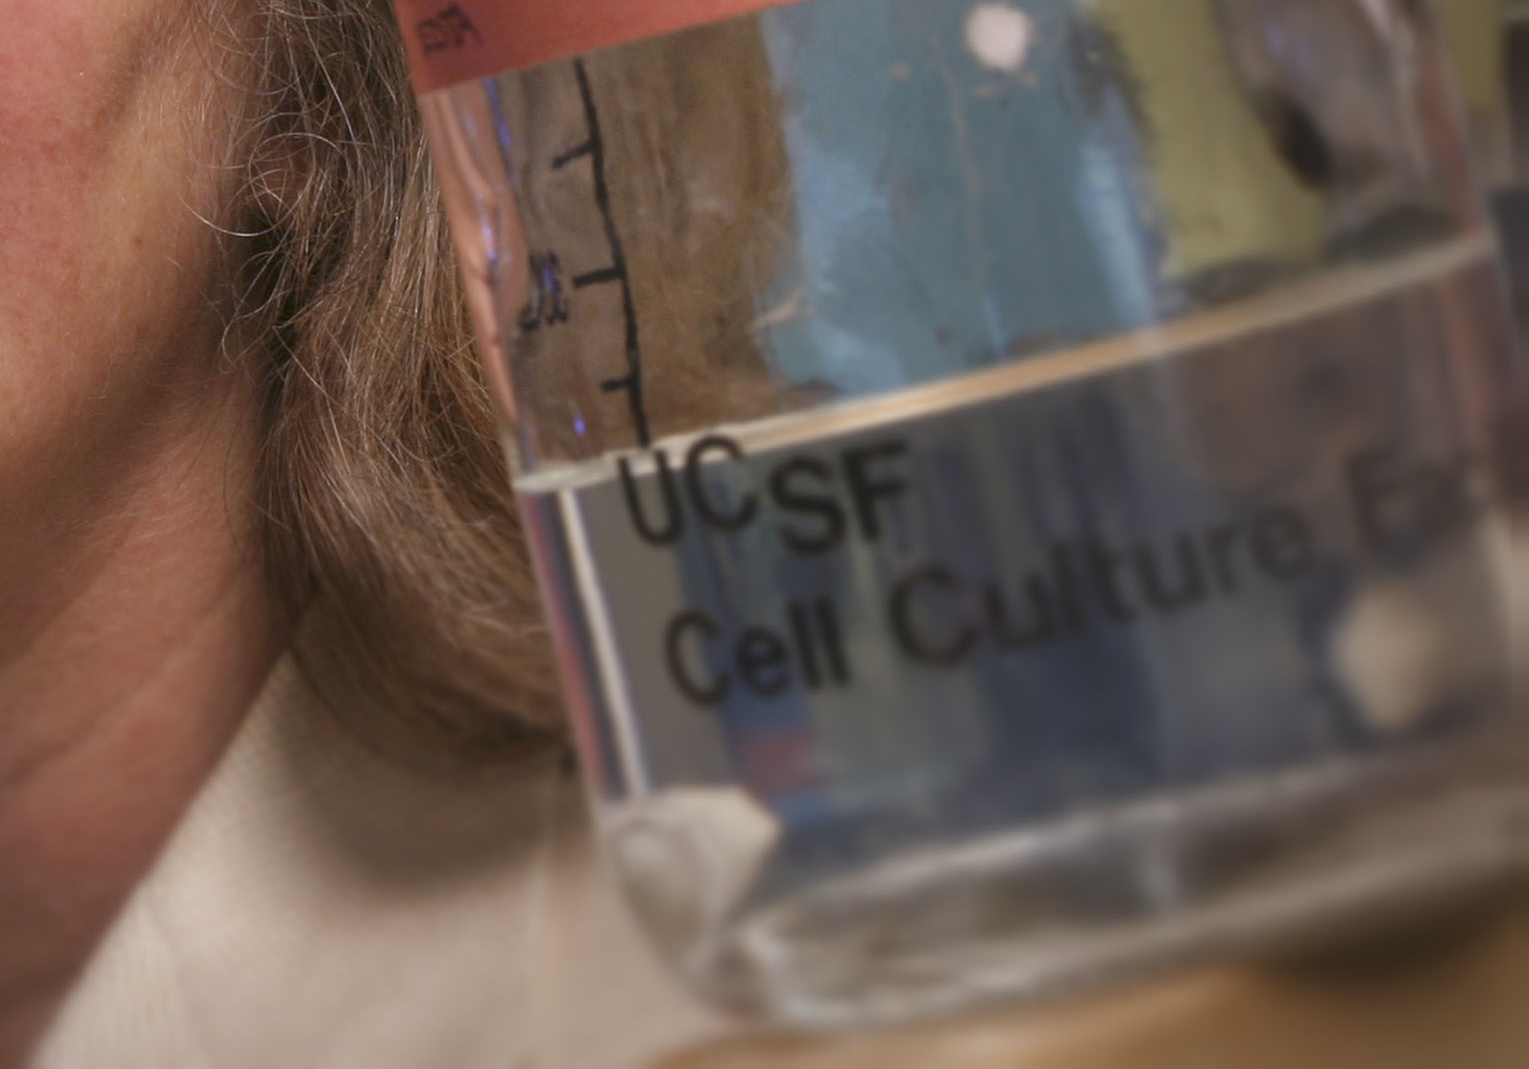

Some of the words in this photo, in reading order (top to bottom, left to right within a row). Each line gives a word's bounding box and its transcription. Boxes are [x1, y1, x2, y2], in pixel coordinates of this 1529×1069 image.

[617, 434, 910, 557] UCSF
[662, 596, 852, 708] Cell
[885, 504, 1316, 670] Culture
